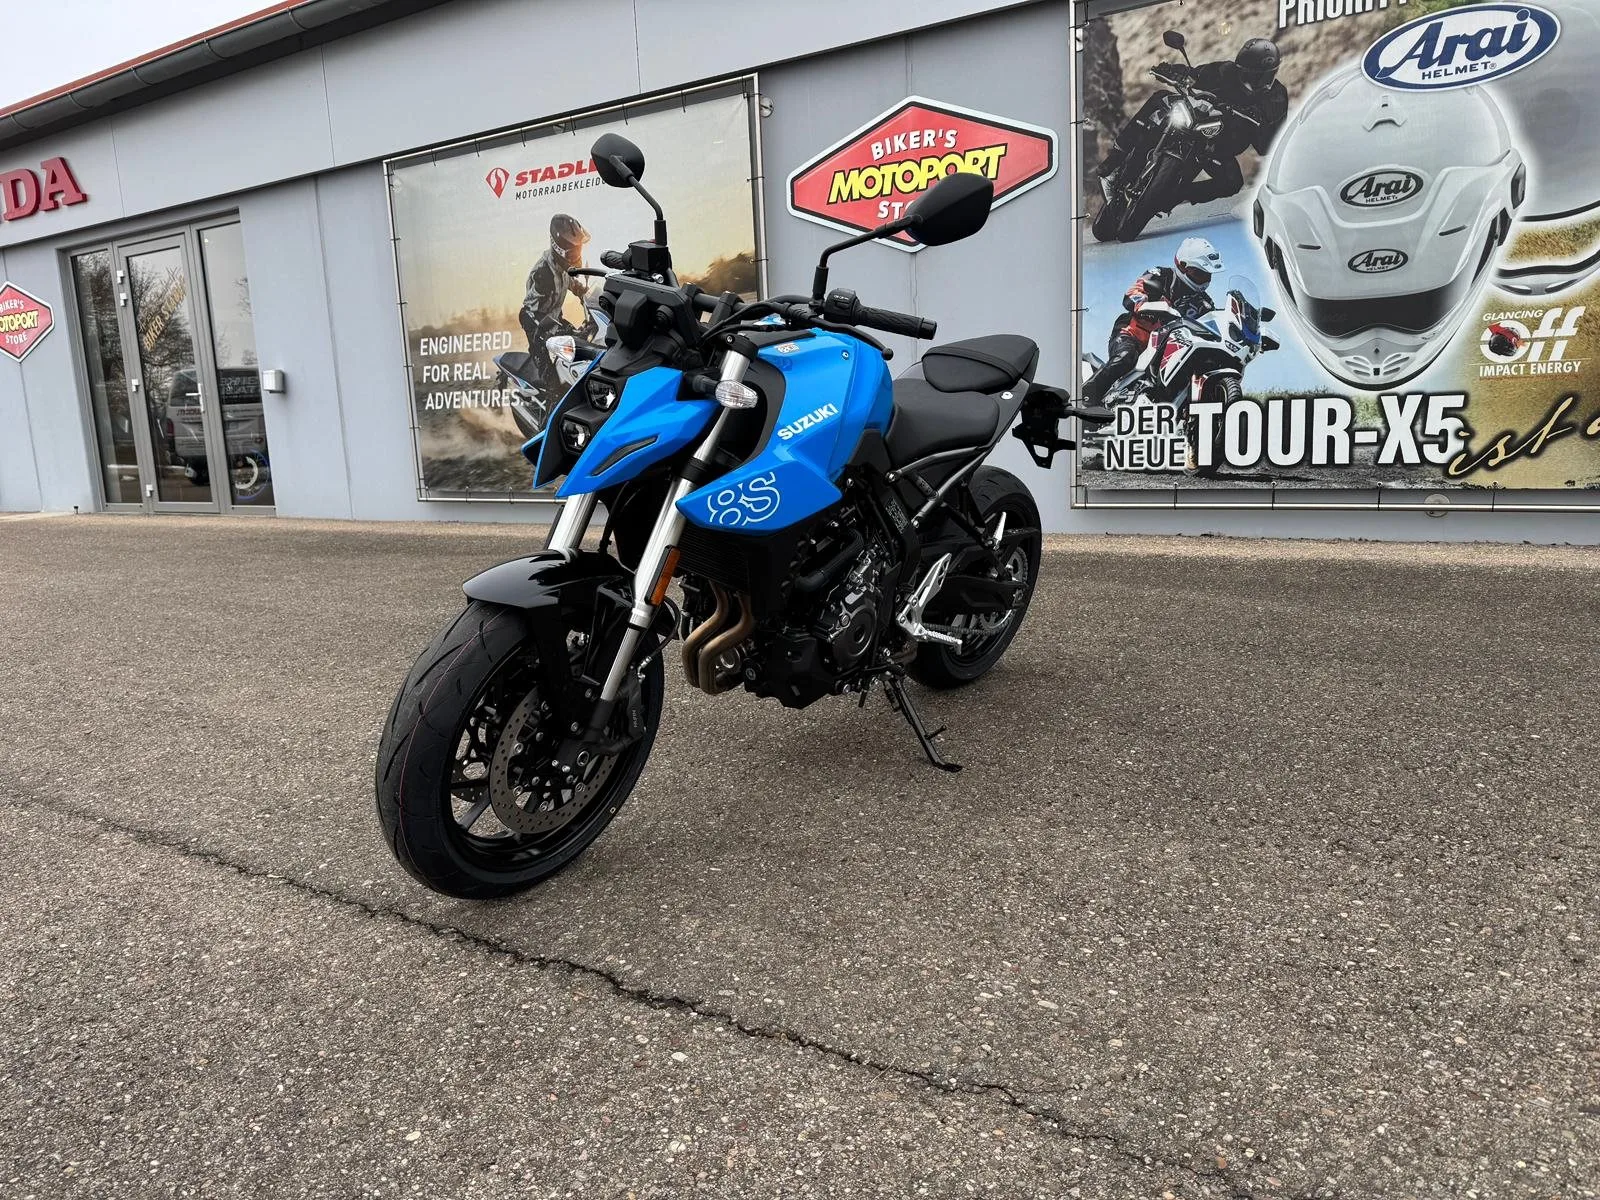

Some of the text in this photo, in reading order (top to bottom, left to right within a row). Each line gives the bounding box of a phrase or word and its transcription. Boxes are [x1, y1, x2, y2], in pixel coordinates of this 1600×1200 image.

[1375, 8, 1533, 78] Arai
[871, 129, 958, 160] BIKER'S
[515, 158, 597, 187] STADL
[826, 143, 1008, 205] MOTOPORT
[0, 157, 87, 222] DA
[515, 177, 605, 200] MOTORRADBEKLEID
[1346, 174, 1413, 200] Arai
[1353, 252, 1401, 268] Arai
[1482, 309, 1543, 321] GLANCING
[5, 331, 28, 345] STORE
[420, 331, 512, 356] ENGINEERED
[423, 361, 491, 383] FOR REAL
[1480, 361, 1581, 377] IMPACT ENERGY
[425, 388, 523, 410] ADVENTURES.
[777, 403, 839, 440] SUZUKI
[1116, 405, 1176, 436] DER
[1189, 394, 1465, 466] TOUR-X5
[1105, 437, 1186, 468] NEUE
